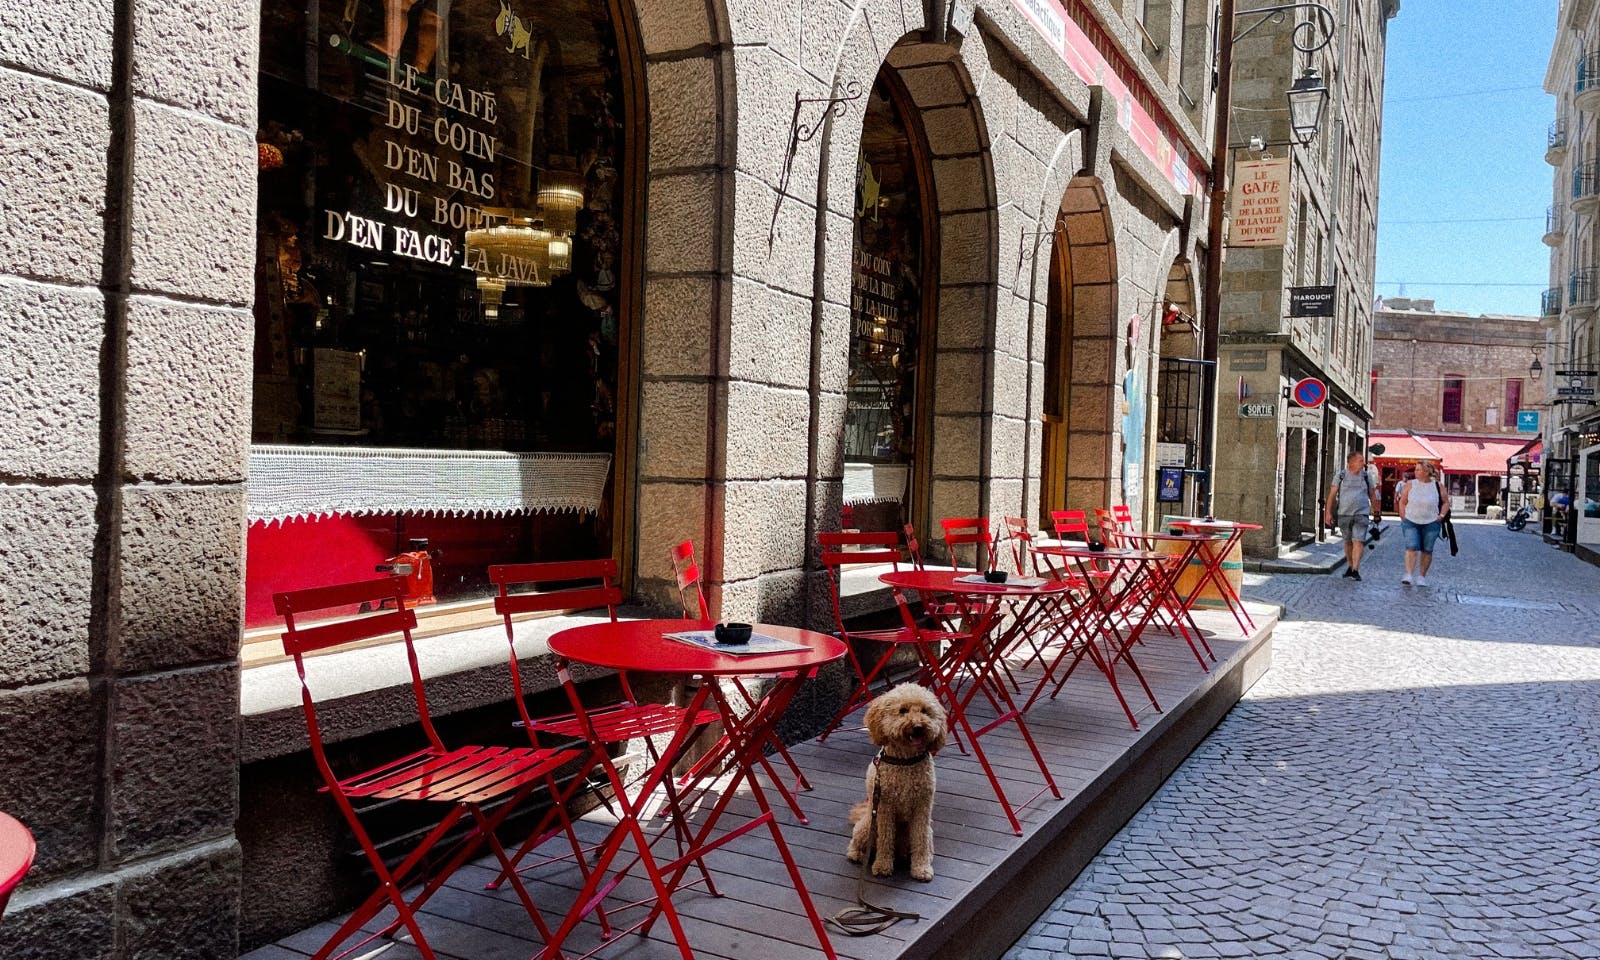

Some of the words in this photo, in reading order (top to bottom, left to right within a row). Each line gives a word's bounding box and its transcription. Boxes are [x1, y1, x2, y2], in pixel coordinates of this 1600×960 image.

[387, 57, 420, 95] LE
[385, 98, 422, 135] DU
[434, 117, 498, 163] COIN
[383, 140, 439, 183] D'EN
[446, 160, 495, 199] BAS
[1255, 171, 1268, 180] LE
[383, 182, 421, 218] DU
[431, 196, 496, 236] BOUT
[1257, 197, 1279, 205] COIN
[1265, 206, 1281, 214] RUE
[1236, 218, 1245, 226] DE
[1259, 216, 1283, 225] VILLE
[1255, 226, 1277, 234] PORT
[323, 209, 386, 251] D'EN
[495, 252, 540, 283] JAVA
[873, 257, 892, 277] COIN
[881, 281, 895, 300] RUE
[1247, 405, 1273, 414] SORTIE
